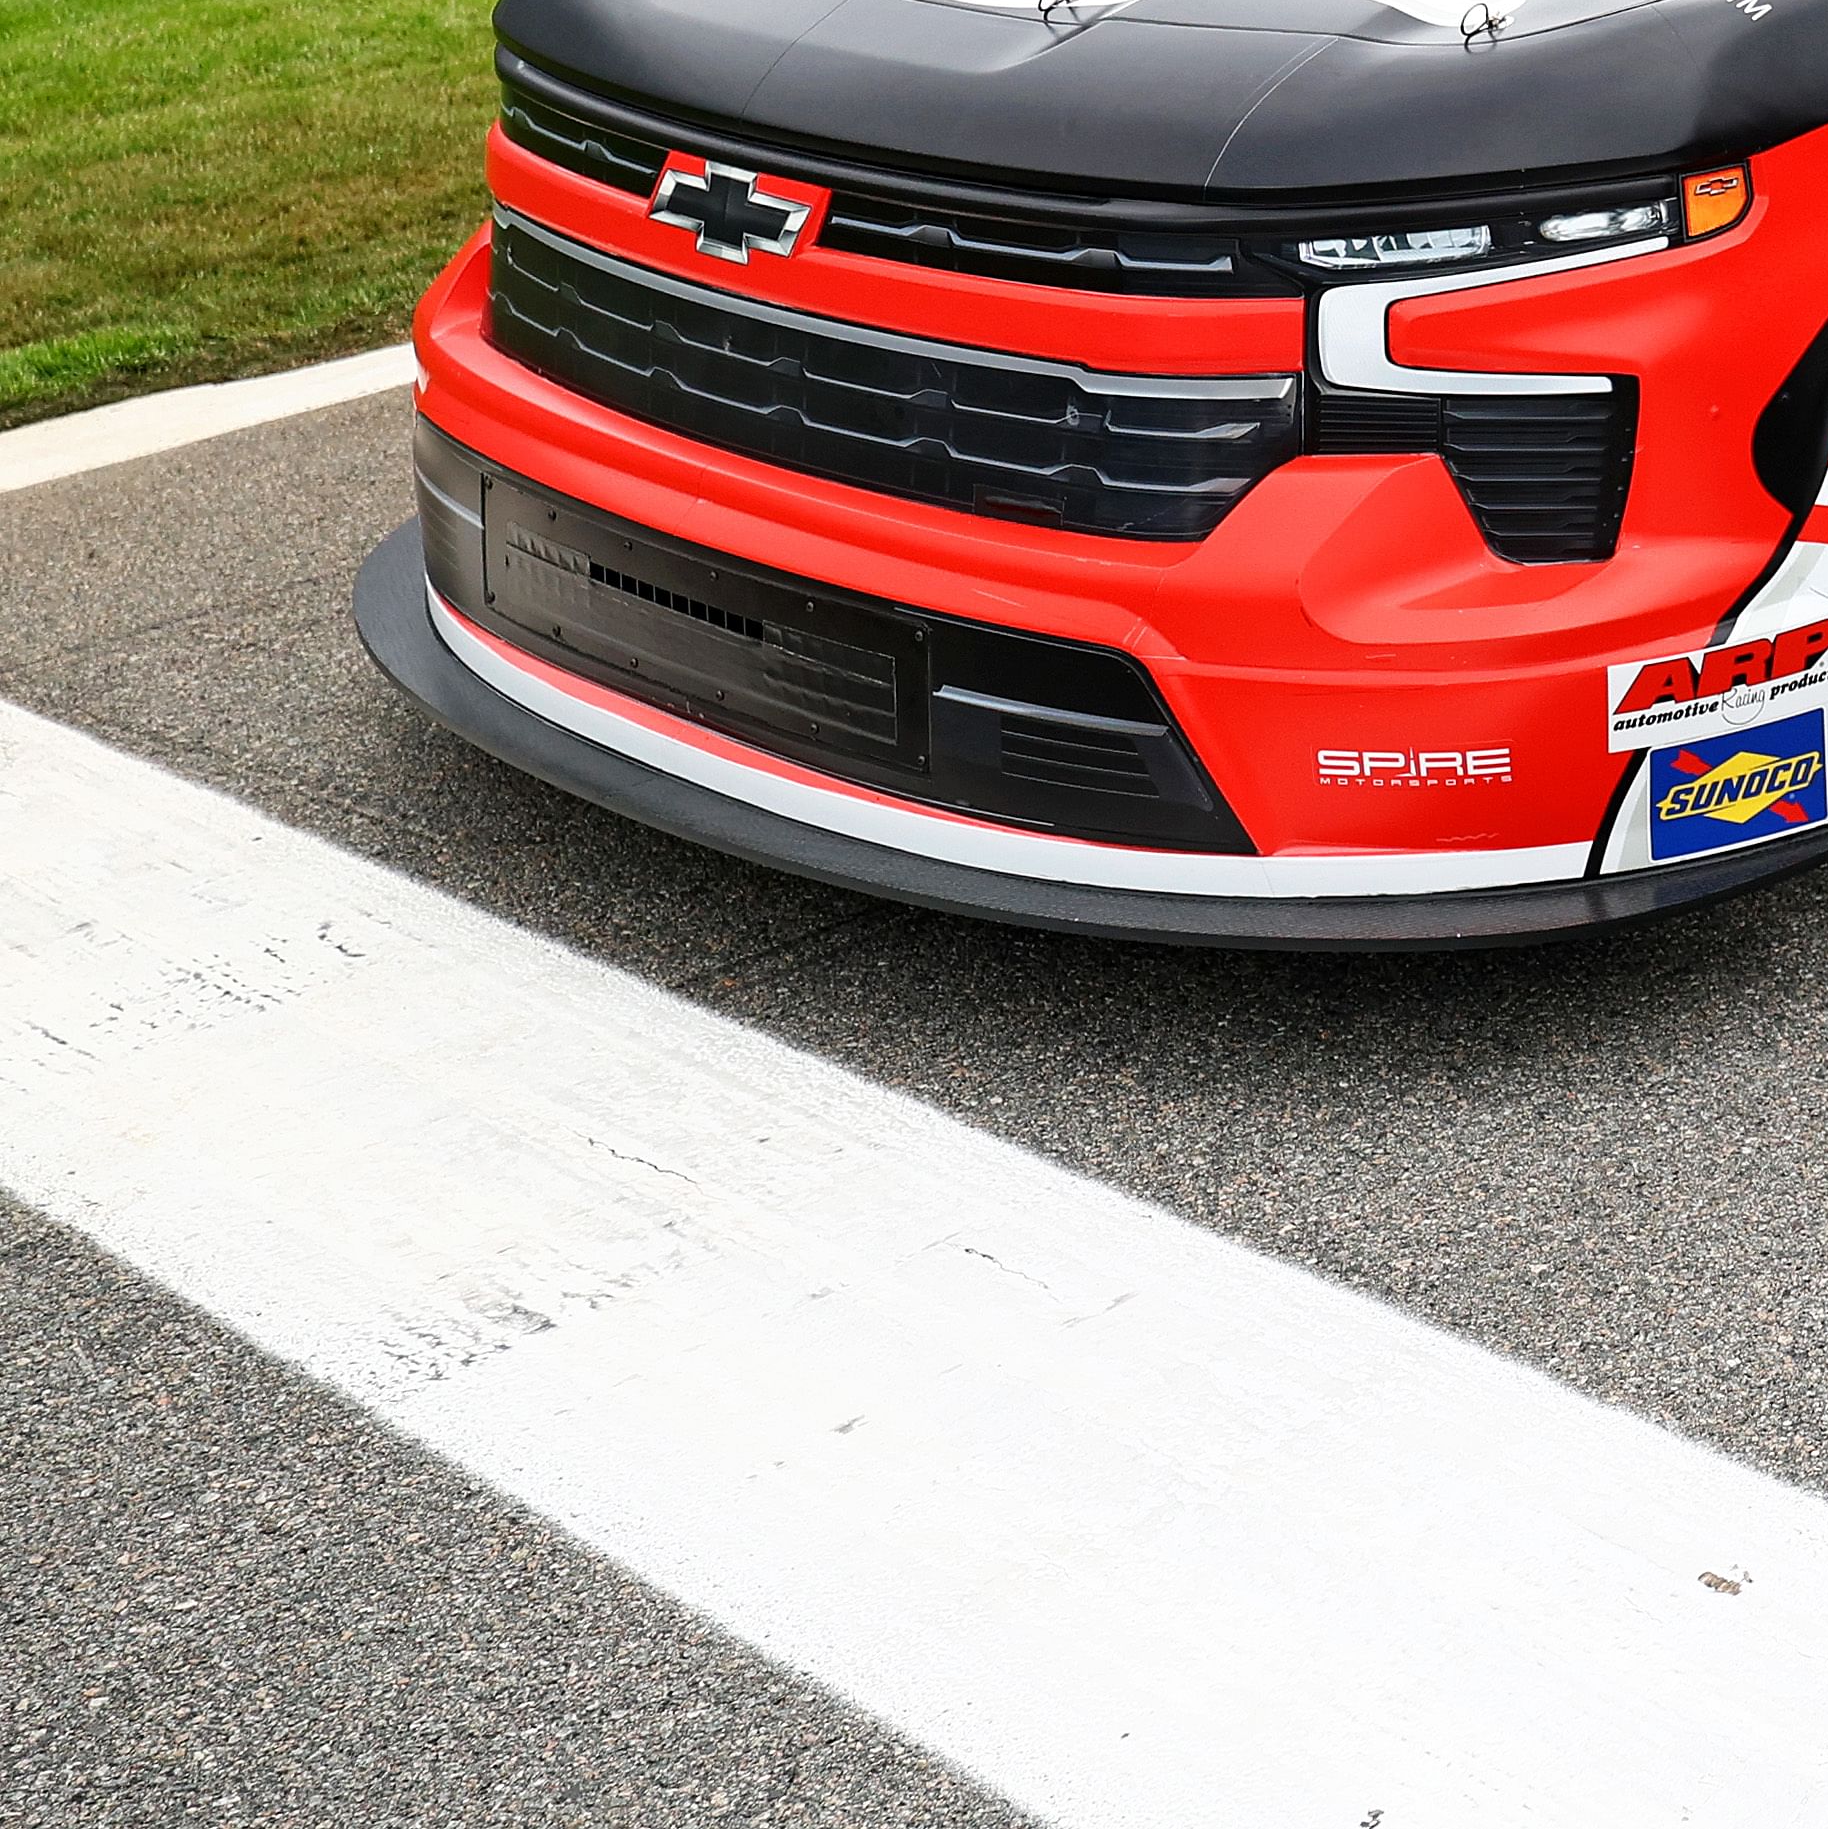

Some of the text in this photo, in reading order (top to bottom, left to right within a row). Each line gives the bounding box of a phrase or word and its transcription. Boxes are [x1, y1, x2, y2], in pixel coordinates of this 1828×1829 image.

[1612, 698, 1719, 732] automotive
[1720, 686, 1765, 715] Racing
[1317, 747, 1512, 776] SPIRE
[1319, 775, 1514, 786] MOTORSPORTS
[1666, 756, 1818, 818] SUNOCO
